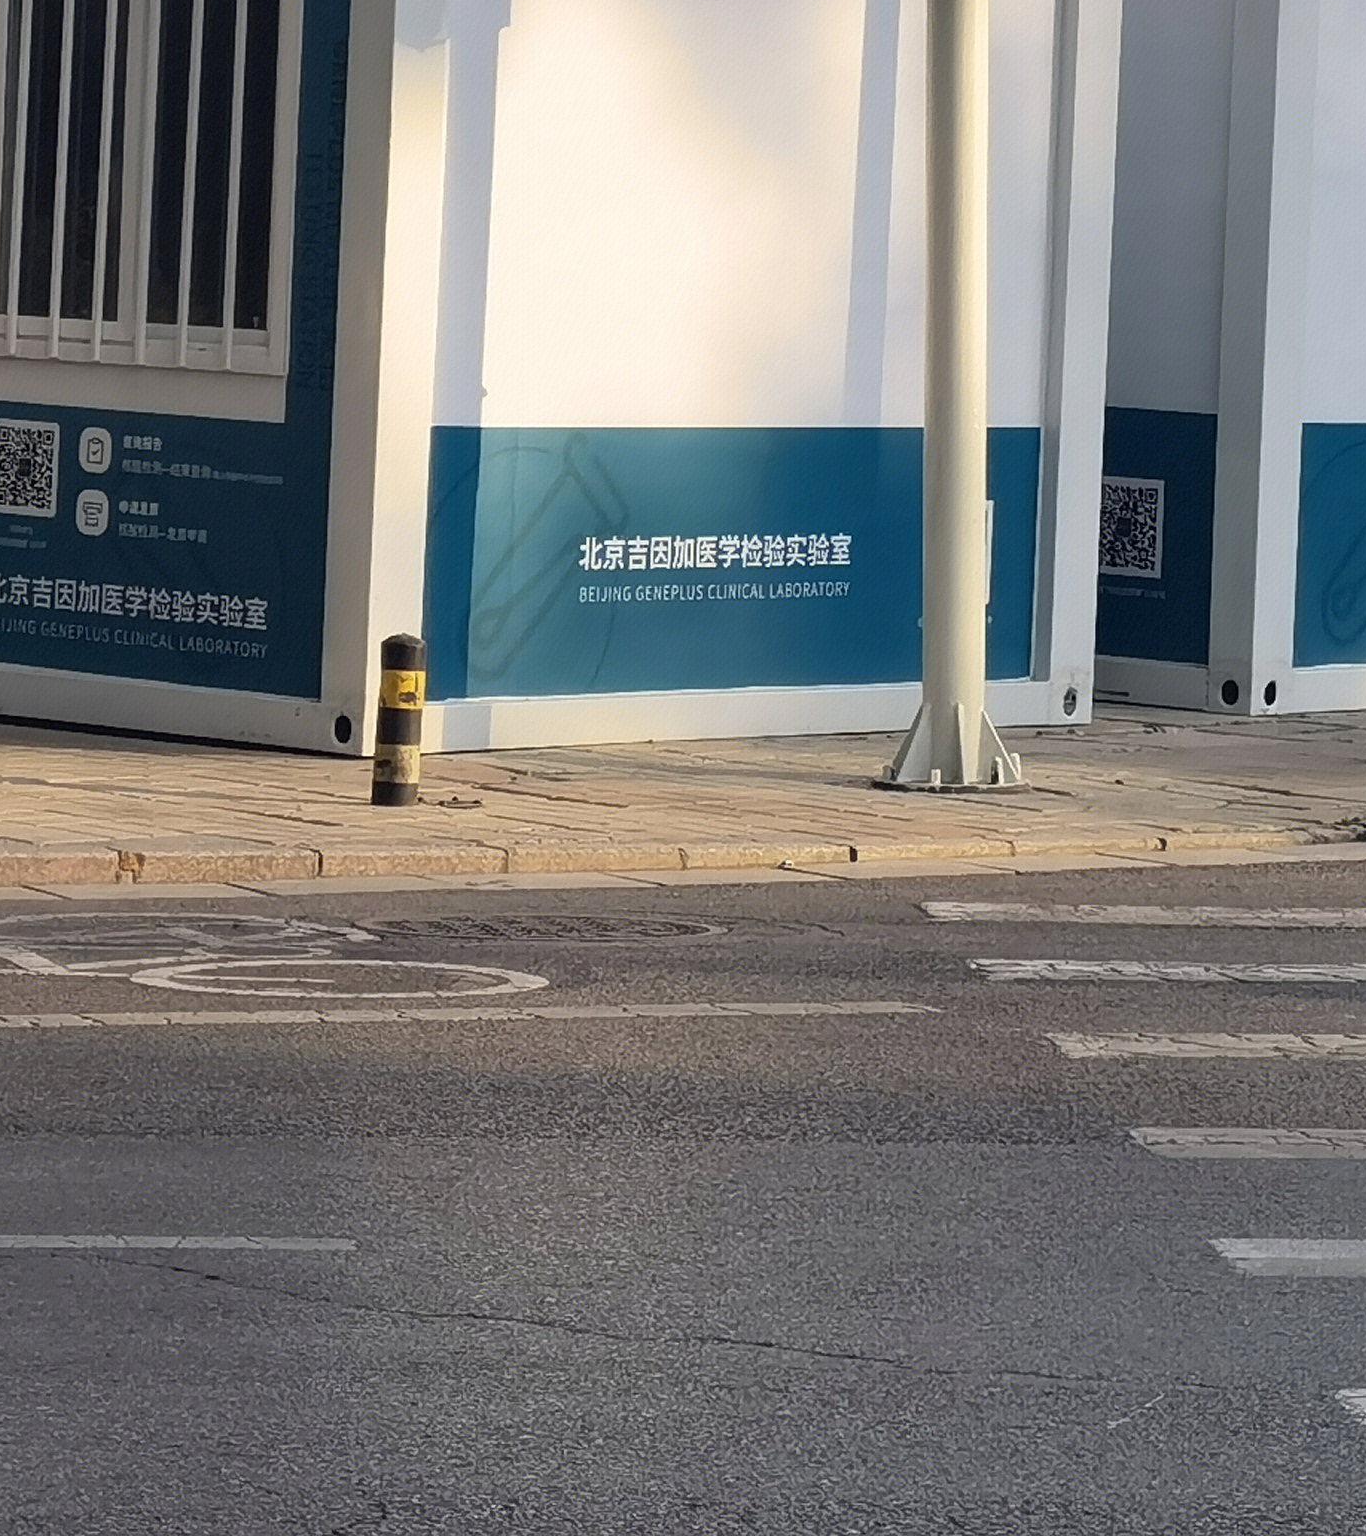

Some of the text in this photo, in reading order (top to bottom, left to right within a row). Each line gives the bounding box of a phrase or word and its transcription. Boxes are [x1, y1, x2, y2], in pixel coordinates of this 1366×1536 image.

[578, 532, 852, 570] 北京吉因加医学检验实验室
[579, 581, 851, 603] BEIJING GENEPLUS CLINICAL LABORATORY
[40, 621, 110, 643] GENEPLUS
[114, 628, 175, 650] CLINICAL
[179, 633, 268, 659] LABORATORY
